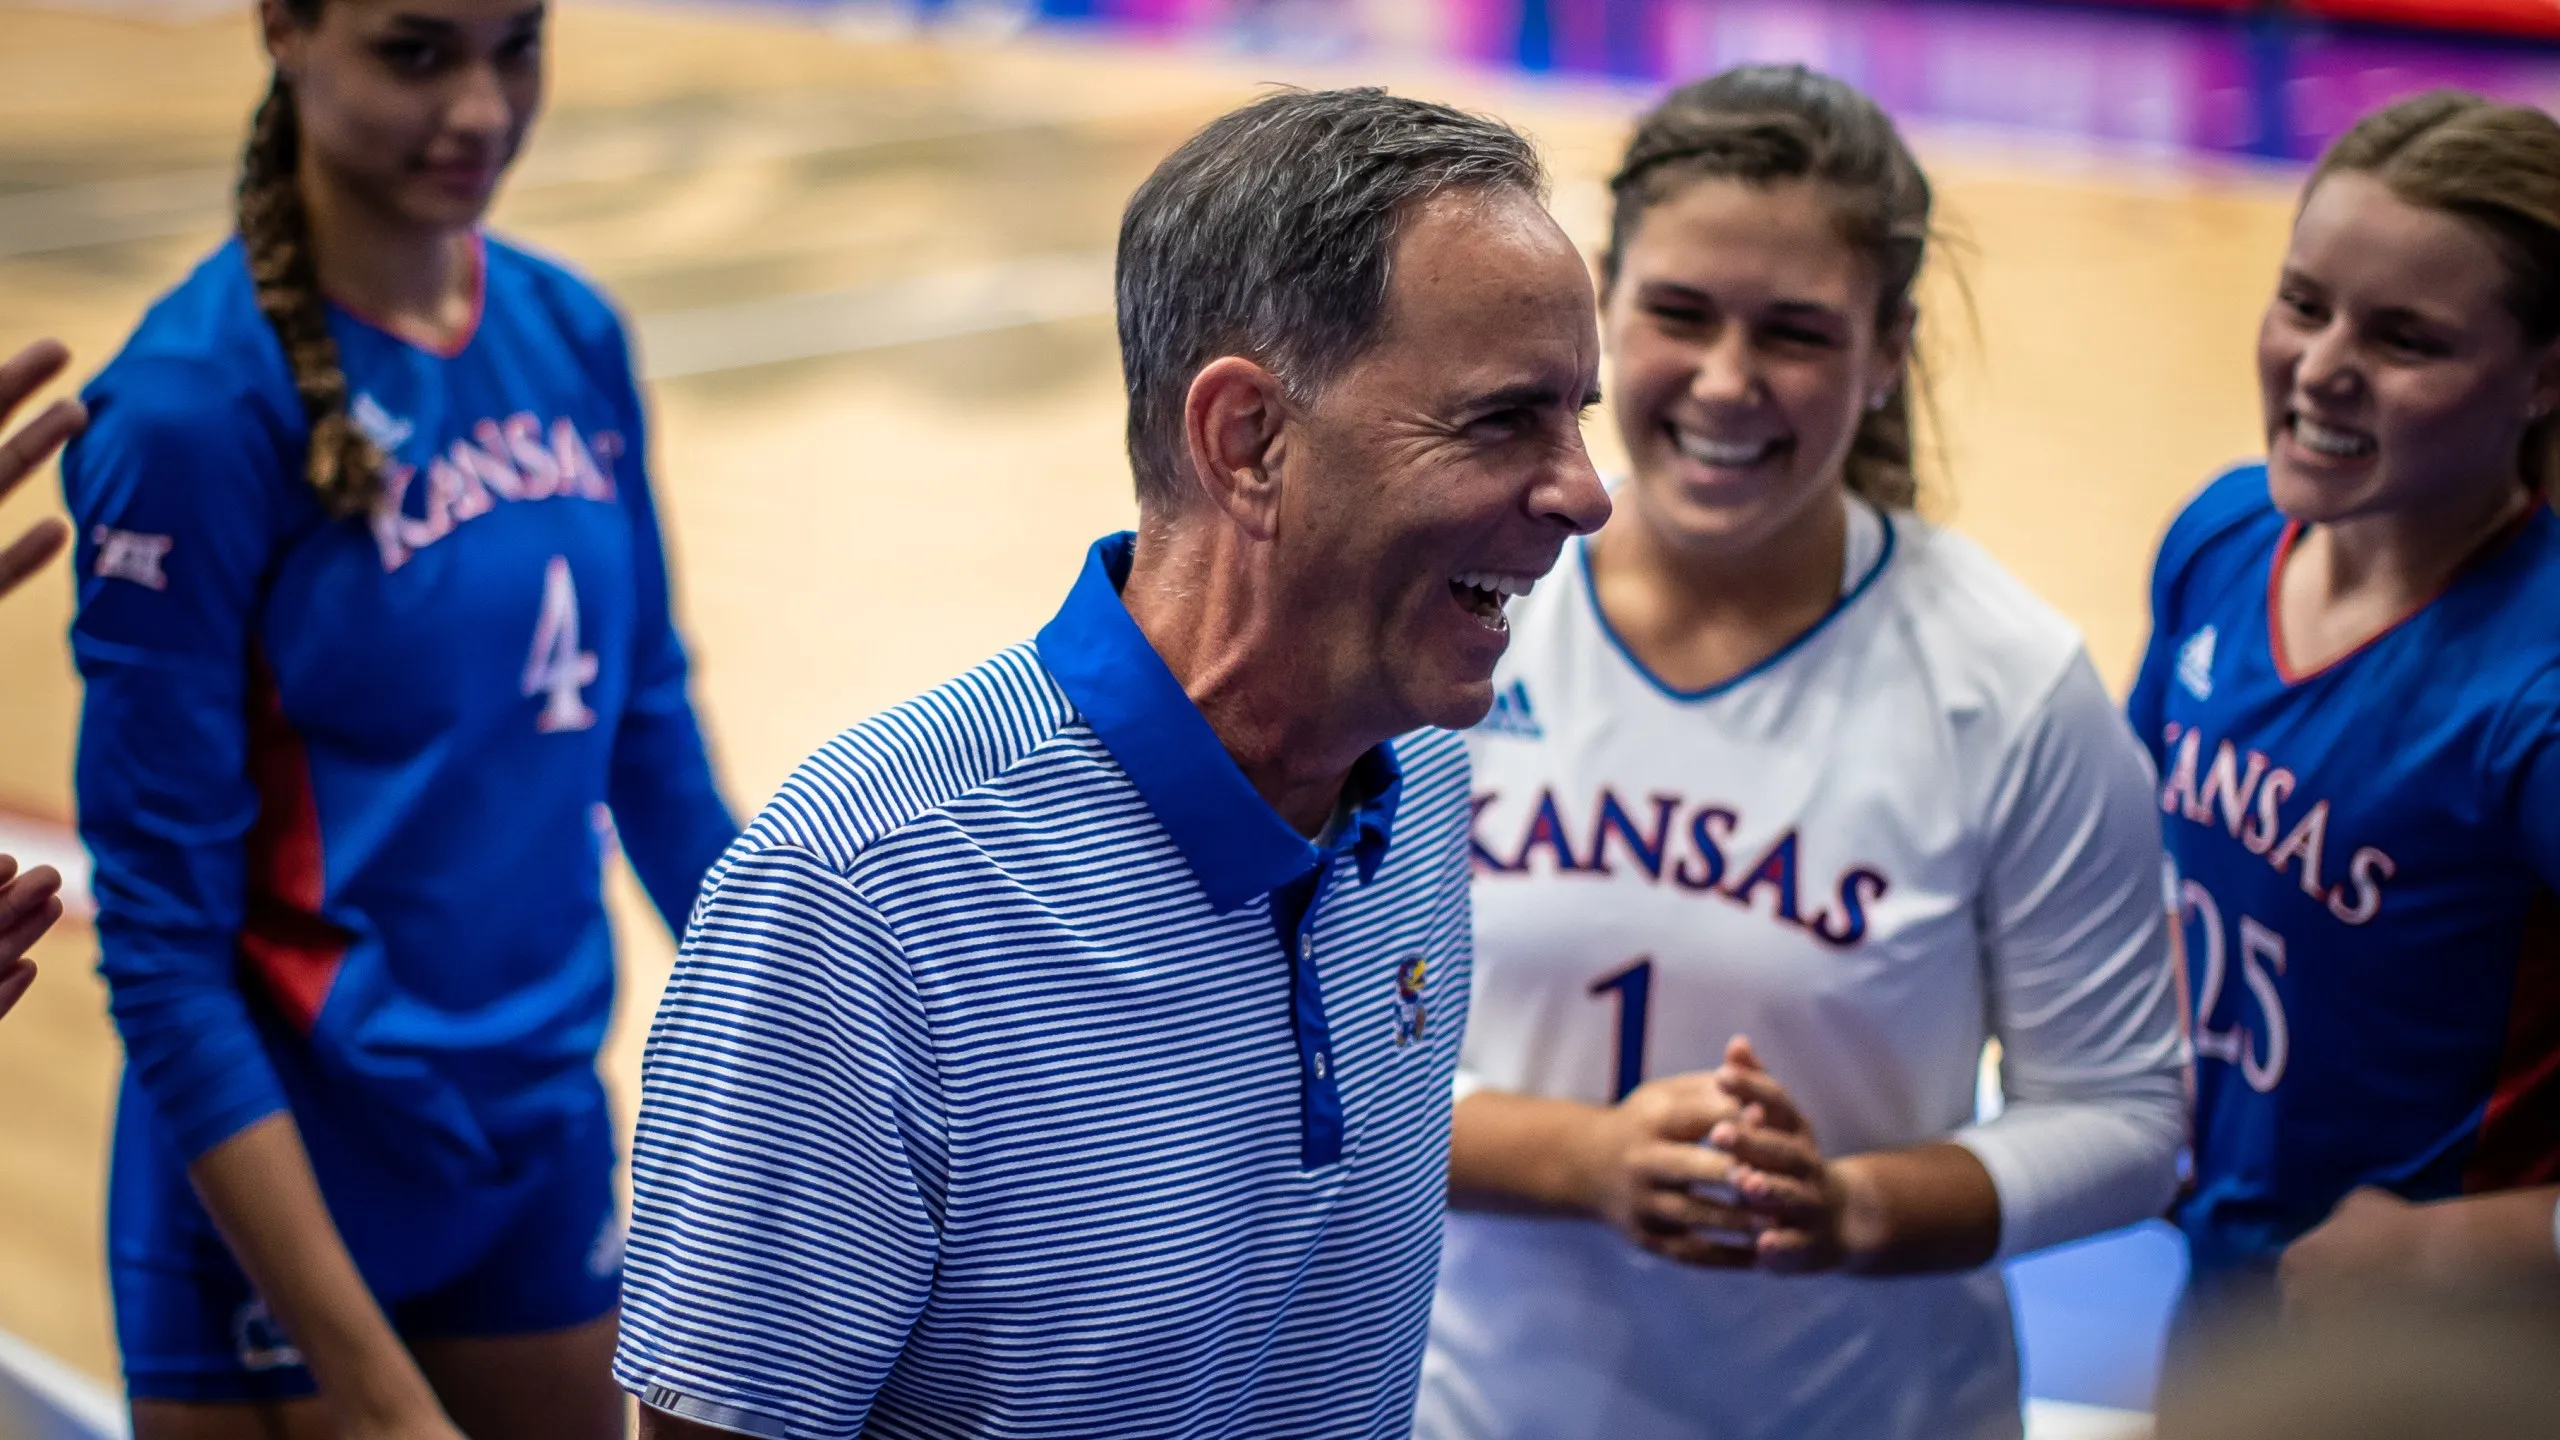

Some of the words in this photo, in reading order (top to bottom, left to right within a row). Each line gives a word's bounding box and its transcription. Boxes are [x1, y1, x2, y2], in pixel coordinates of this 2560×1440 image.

[521, 555, 597, 733] 4
[2162, 721, 2396, 926] ANSAS
[1590, 955, 1655, 1104] 1
[2183, 879, 2290, 1093] 25
